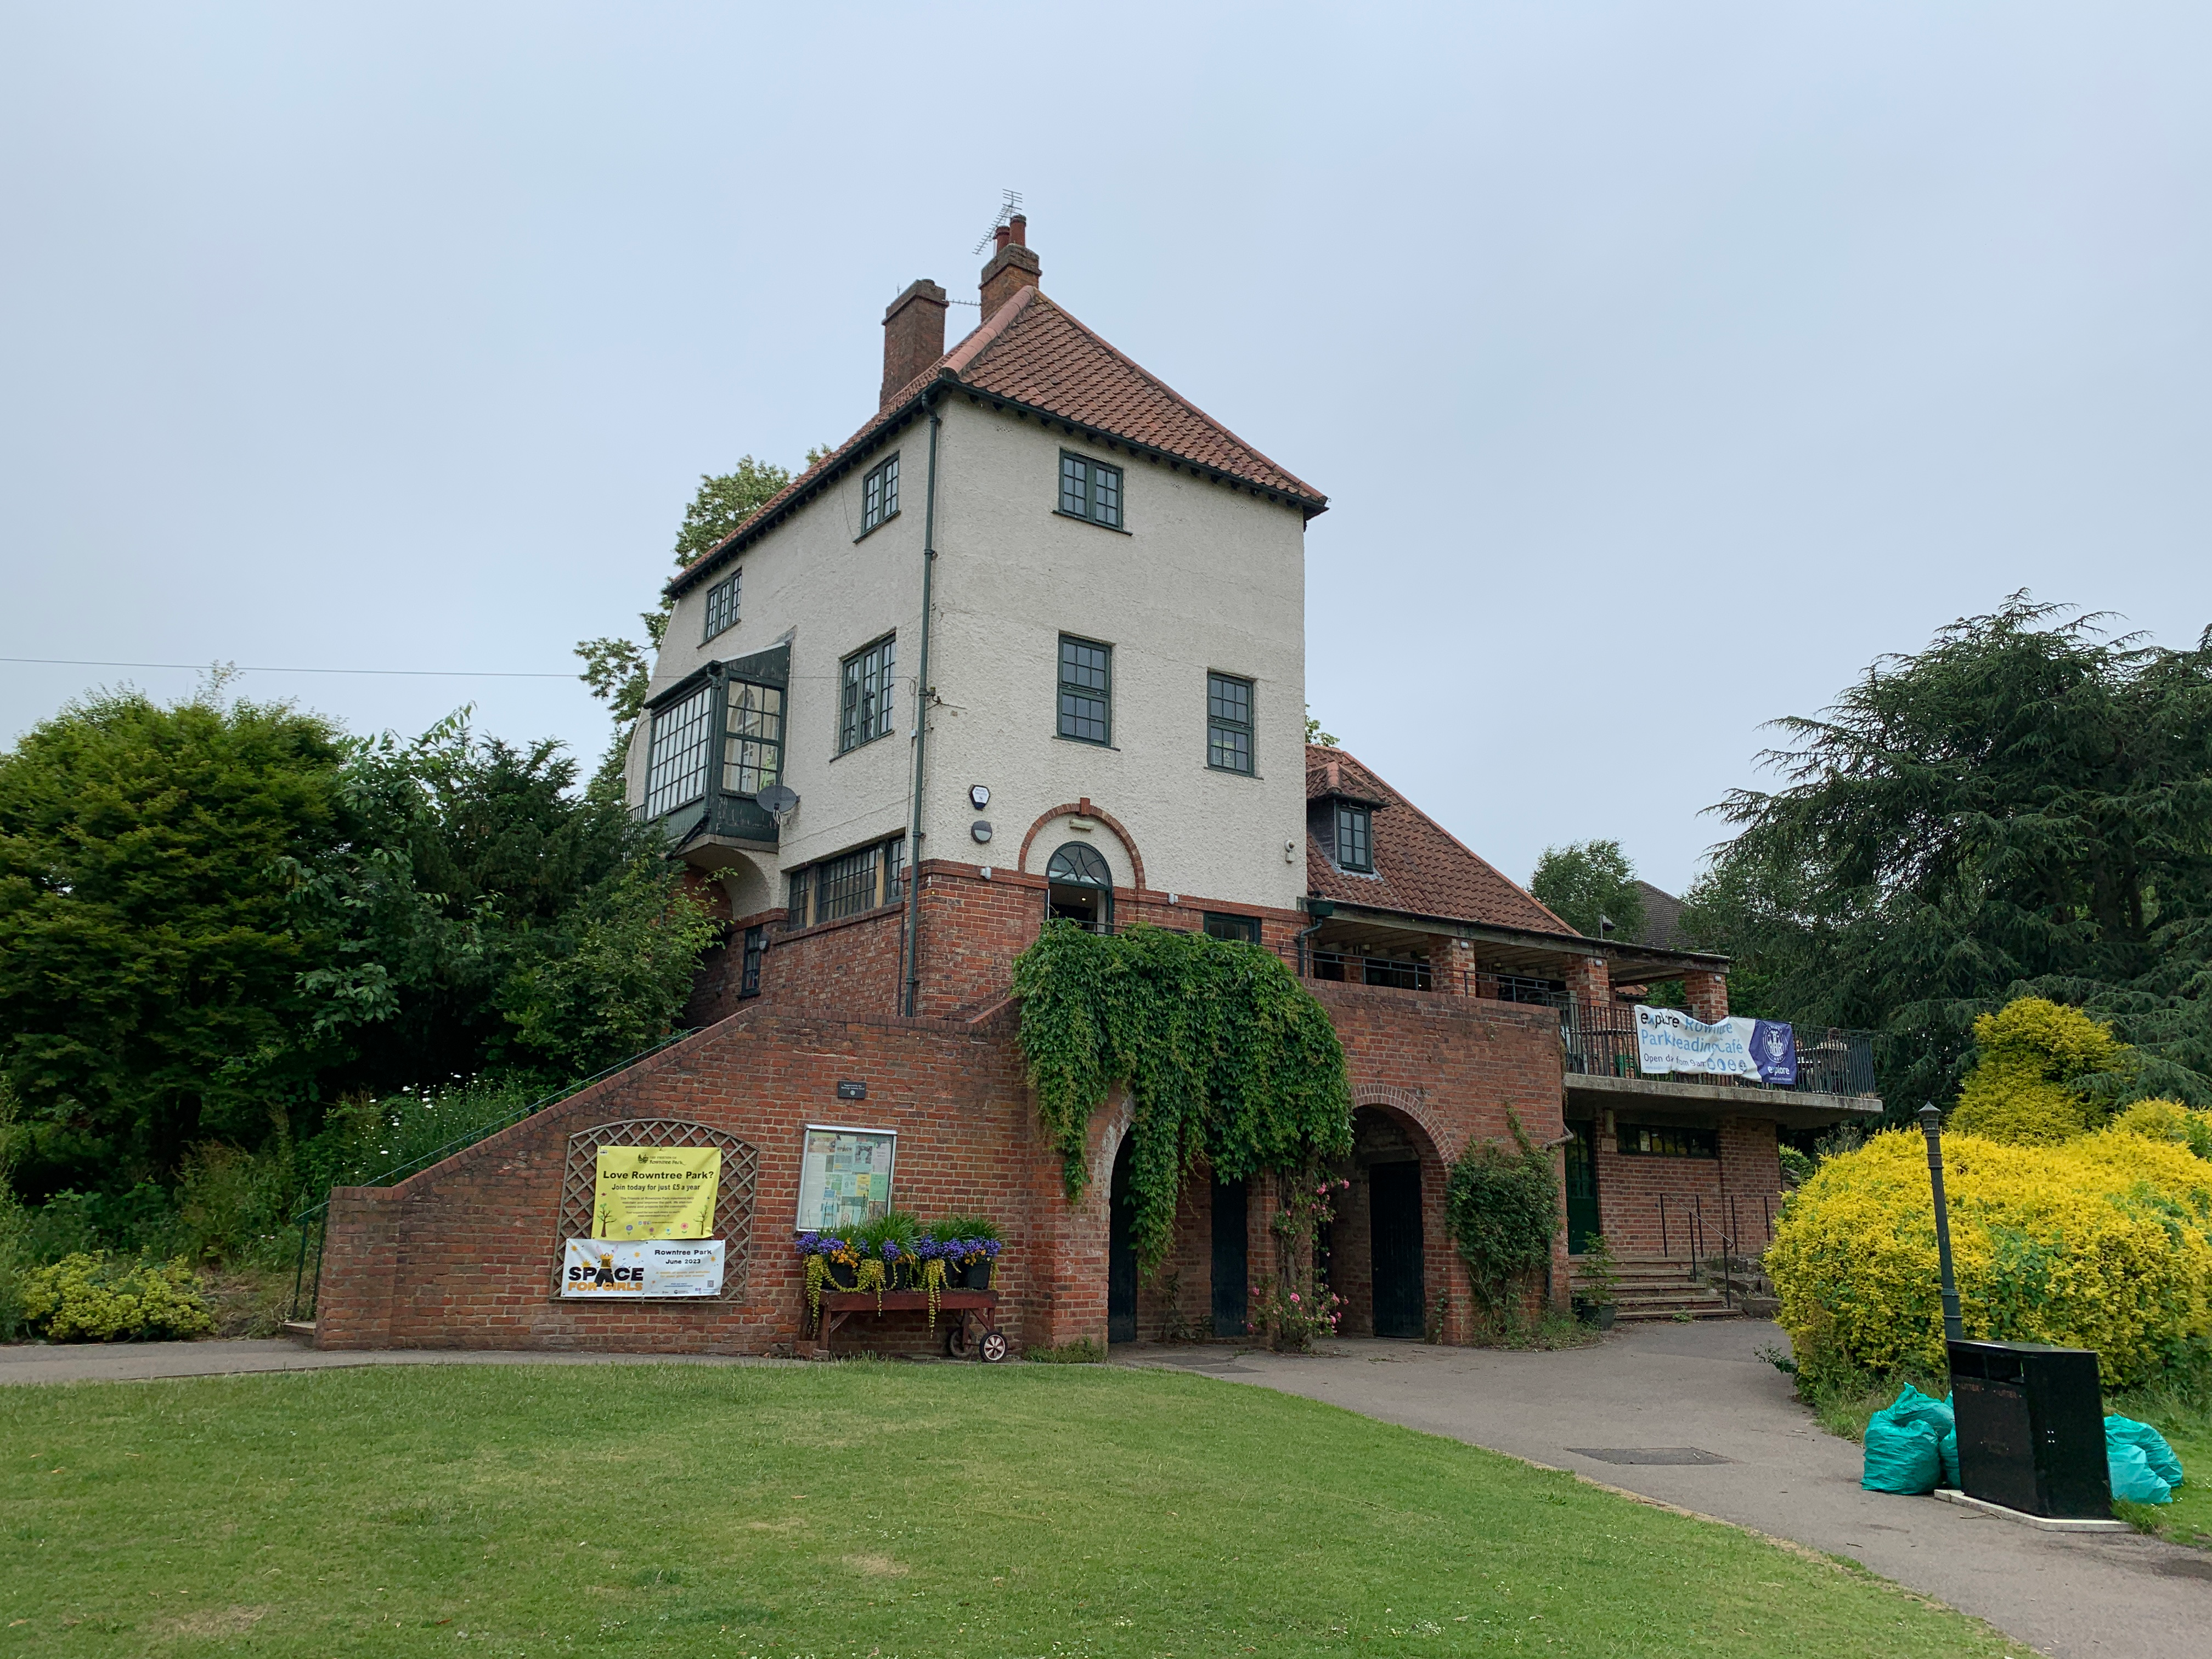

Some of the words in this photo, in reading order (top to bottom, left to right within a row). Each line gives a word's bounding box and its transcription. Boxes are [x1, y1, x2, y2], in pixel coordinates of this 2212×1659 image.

[1640, 1012, 1680, 1029] explore
[1641, 1029, 1672, 1045] Park
[1644, 1053, 1663, 1063] Open
[1676, 1056, 1689, 1066] fom
[603, 1171, 629, 1179] Love
[568, 1267, 644, 1281] SPACE
[568, 1282, 597, 1291] FOR
[602, 1282, 643, 1291] GIRLS
